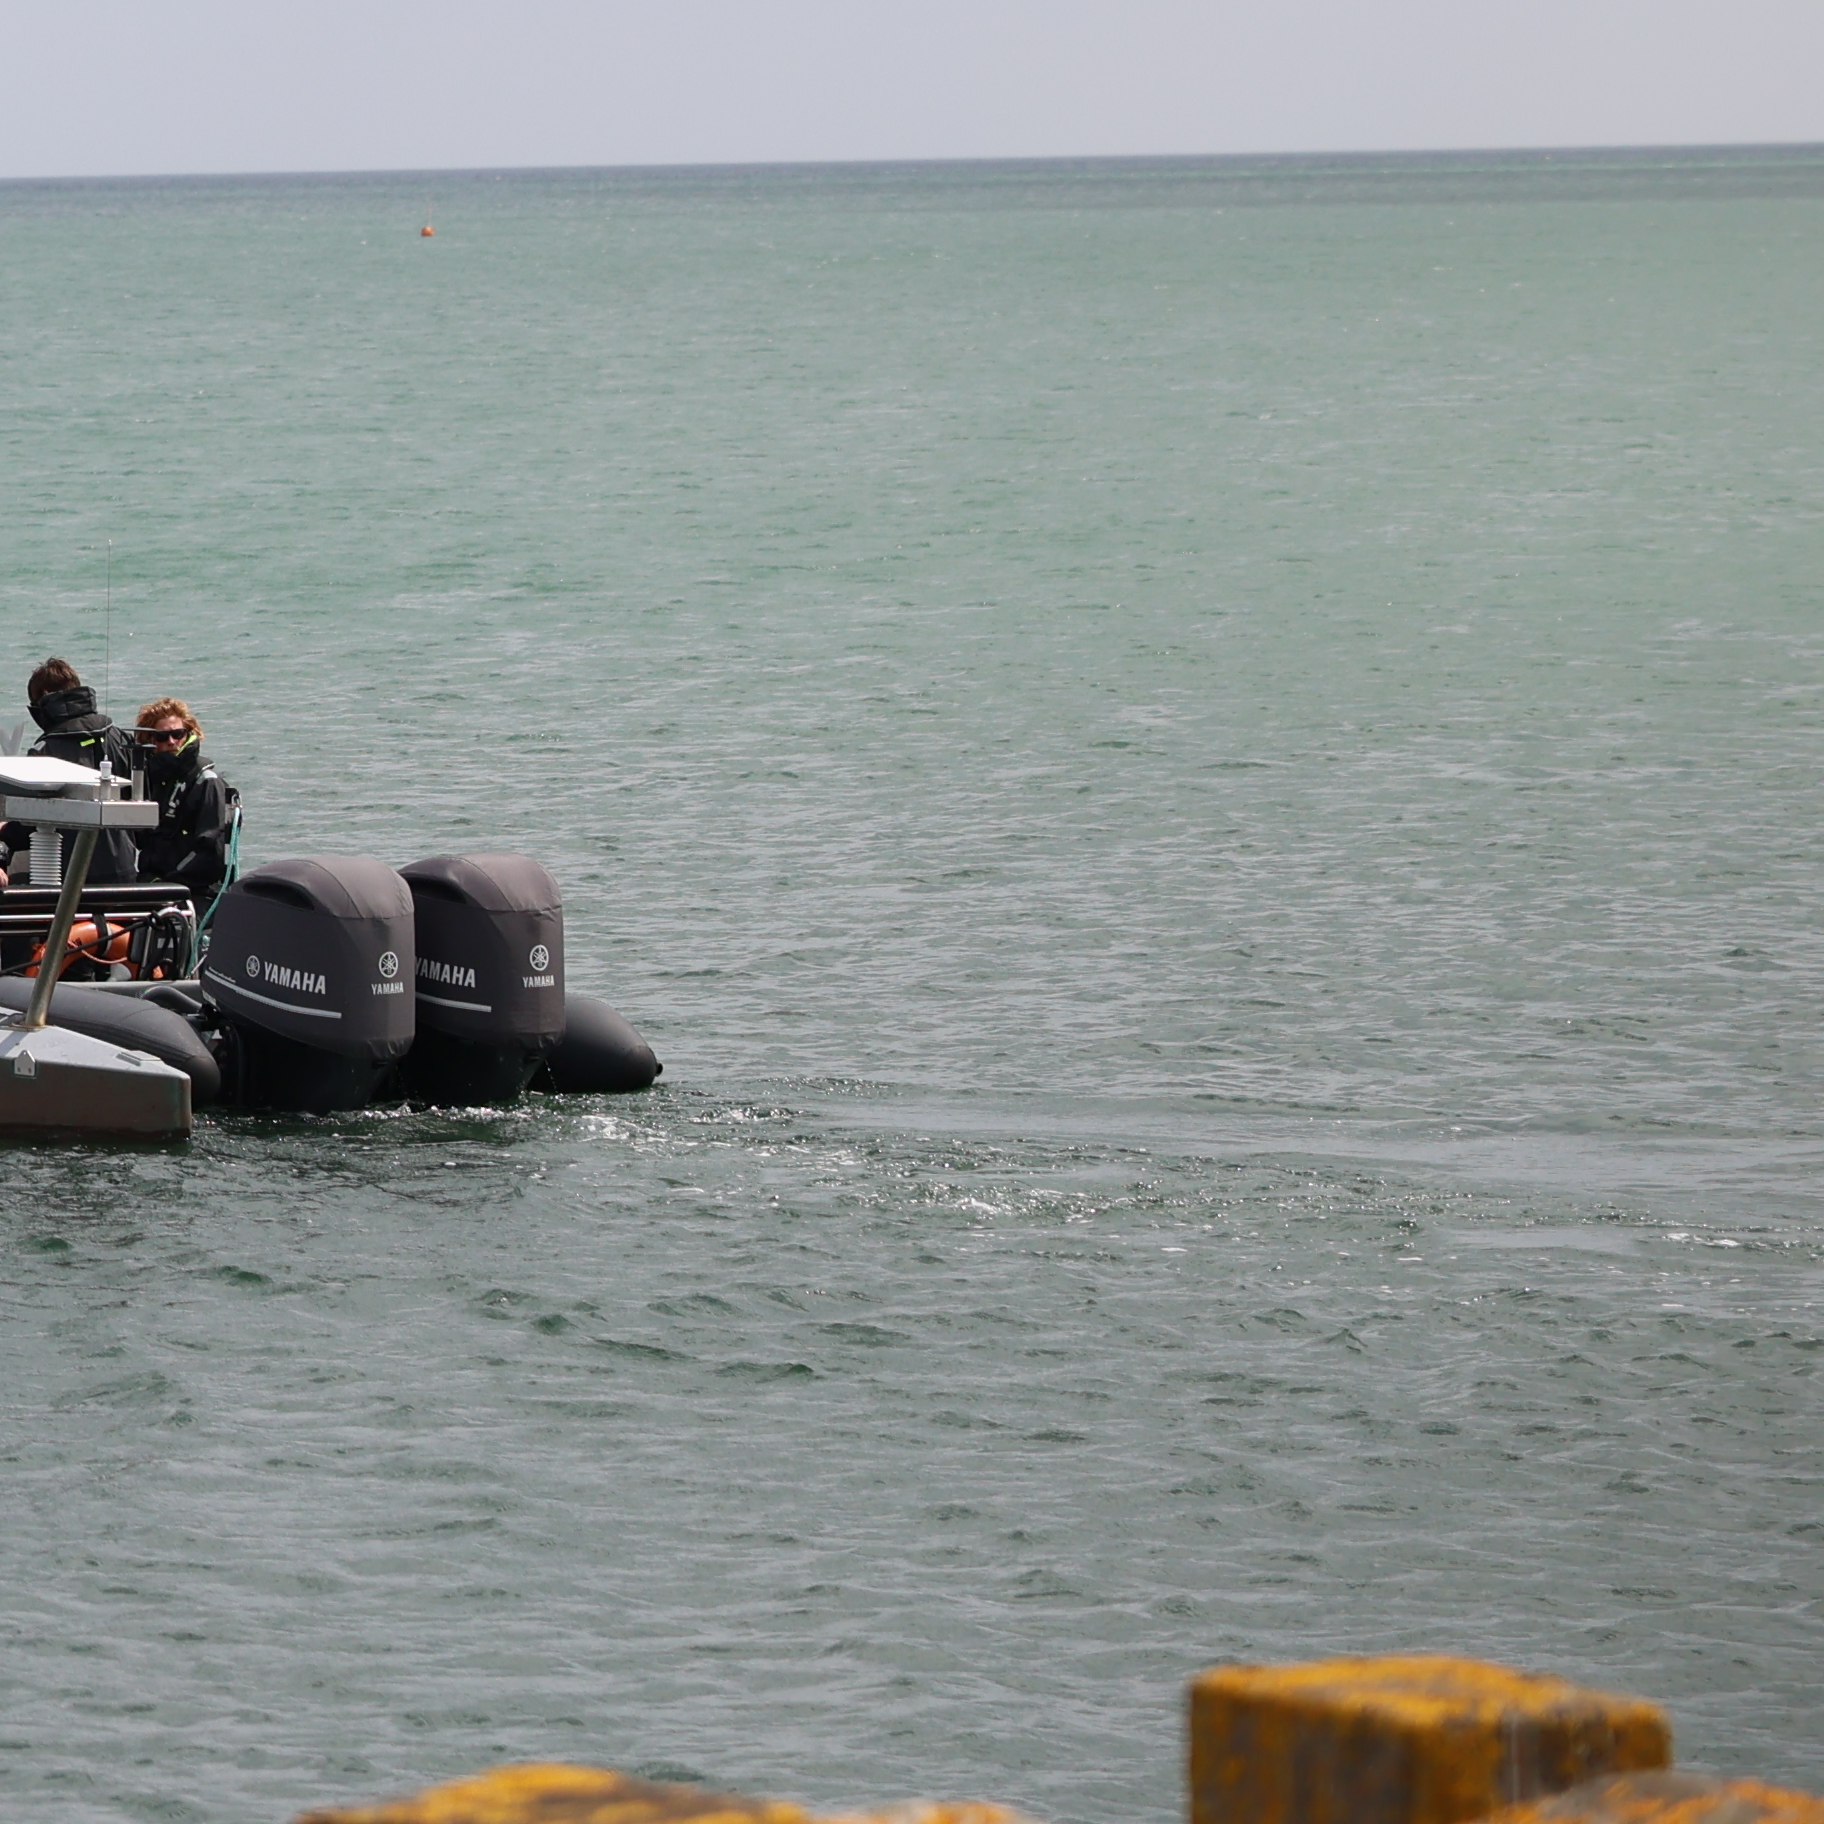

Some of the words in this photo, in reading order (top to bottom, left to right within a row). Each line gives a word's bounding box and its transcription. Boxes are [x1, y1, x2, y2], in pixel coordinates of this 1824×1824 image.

[264, 961, 327, 995] YAMAHA
[414, 957, 476, 989] YAMAHA
[522, 974, 555, 988] YAMAHA
[370, 981, 404, 996] YAMAHA
